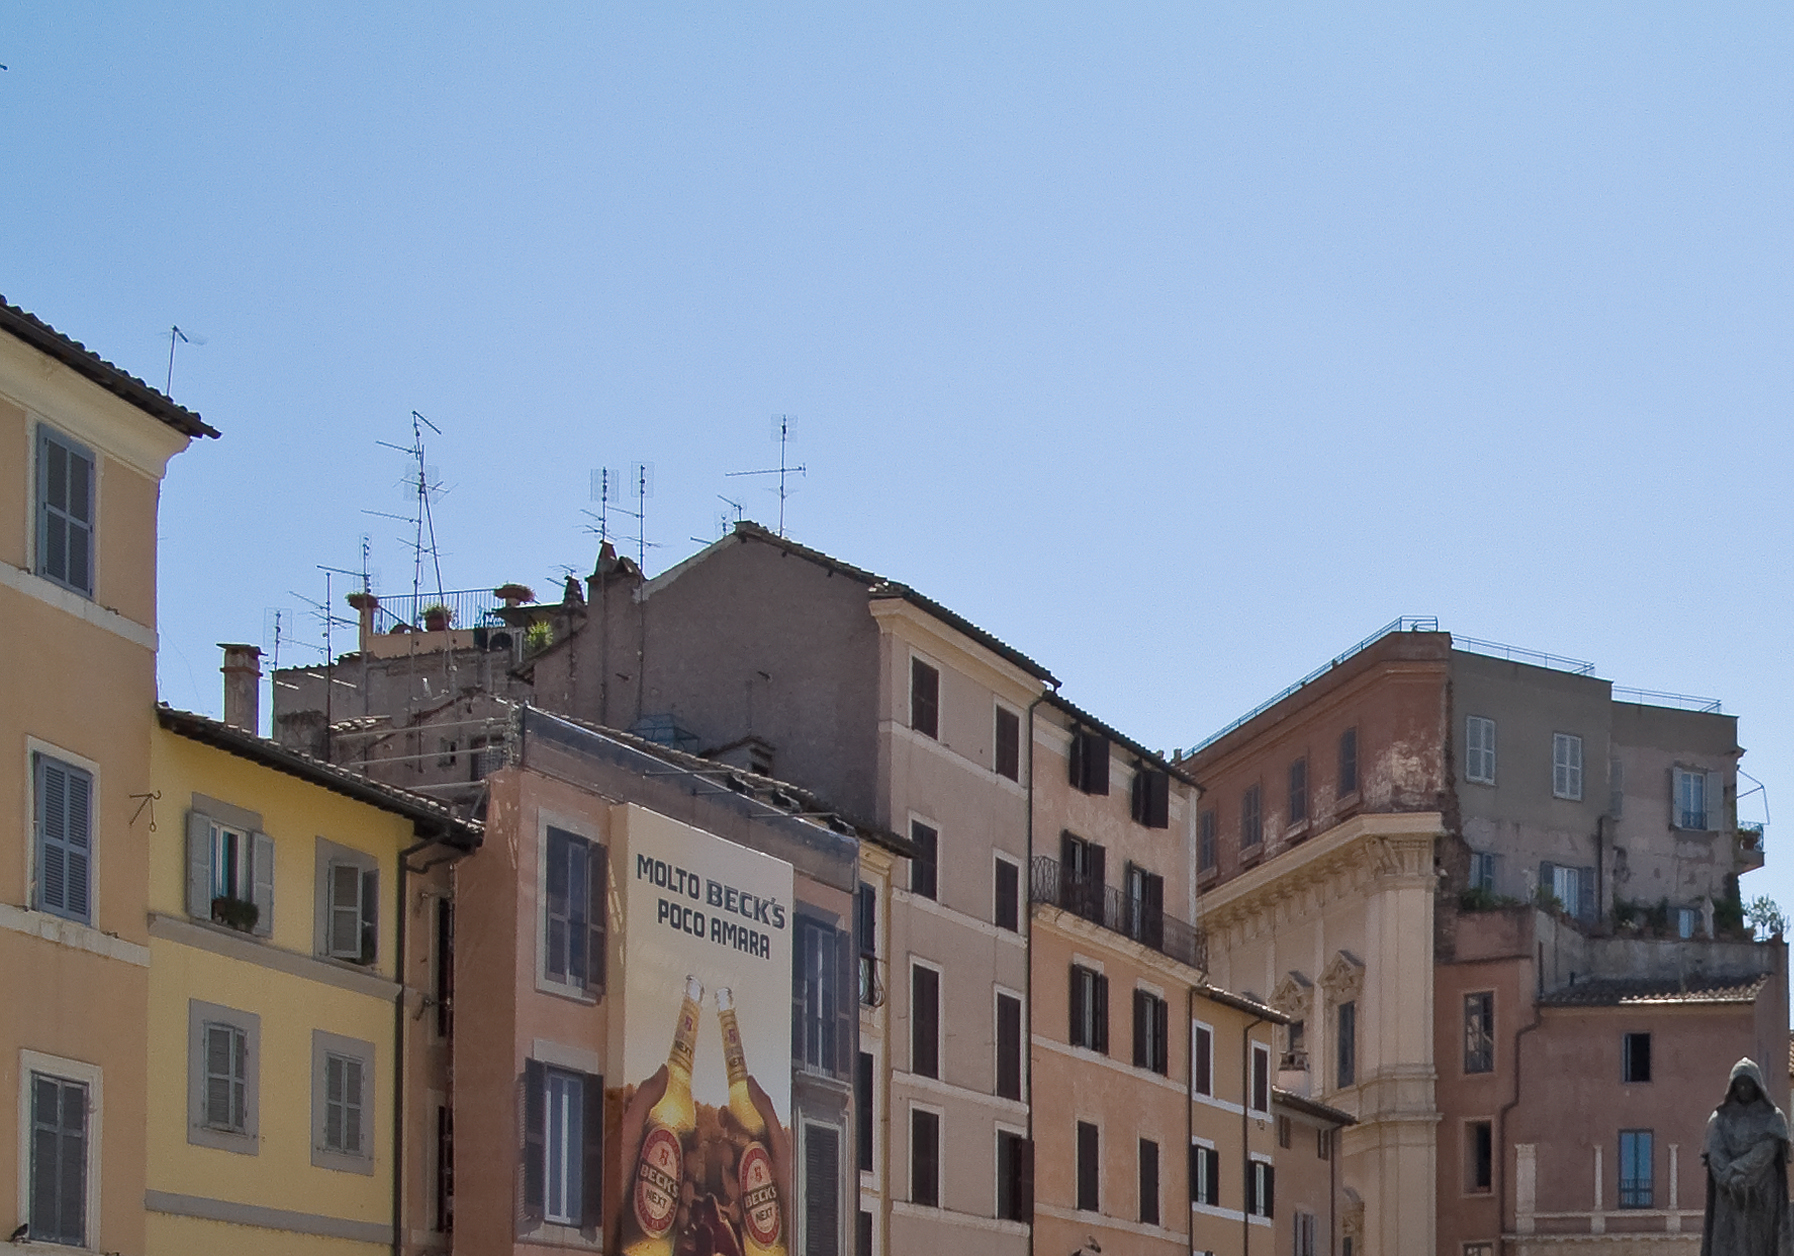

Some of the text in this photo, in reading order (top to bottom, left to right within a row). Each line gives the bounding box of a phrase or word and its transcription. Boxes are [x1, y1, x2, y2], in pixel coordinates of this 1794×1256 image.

[637, 854, 785, 930] MOLTO BECK'S
[657, 898, 770, 960] POCO AMARA
